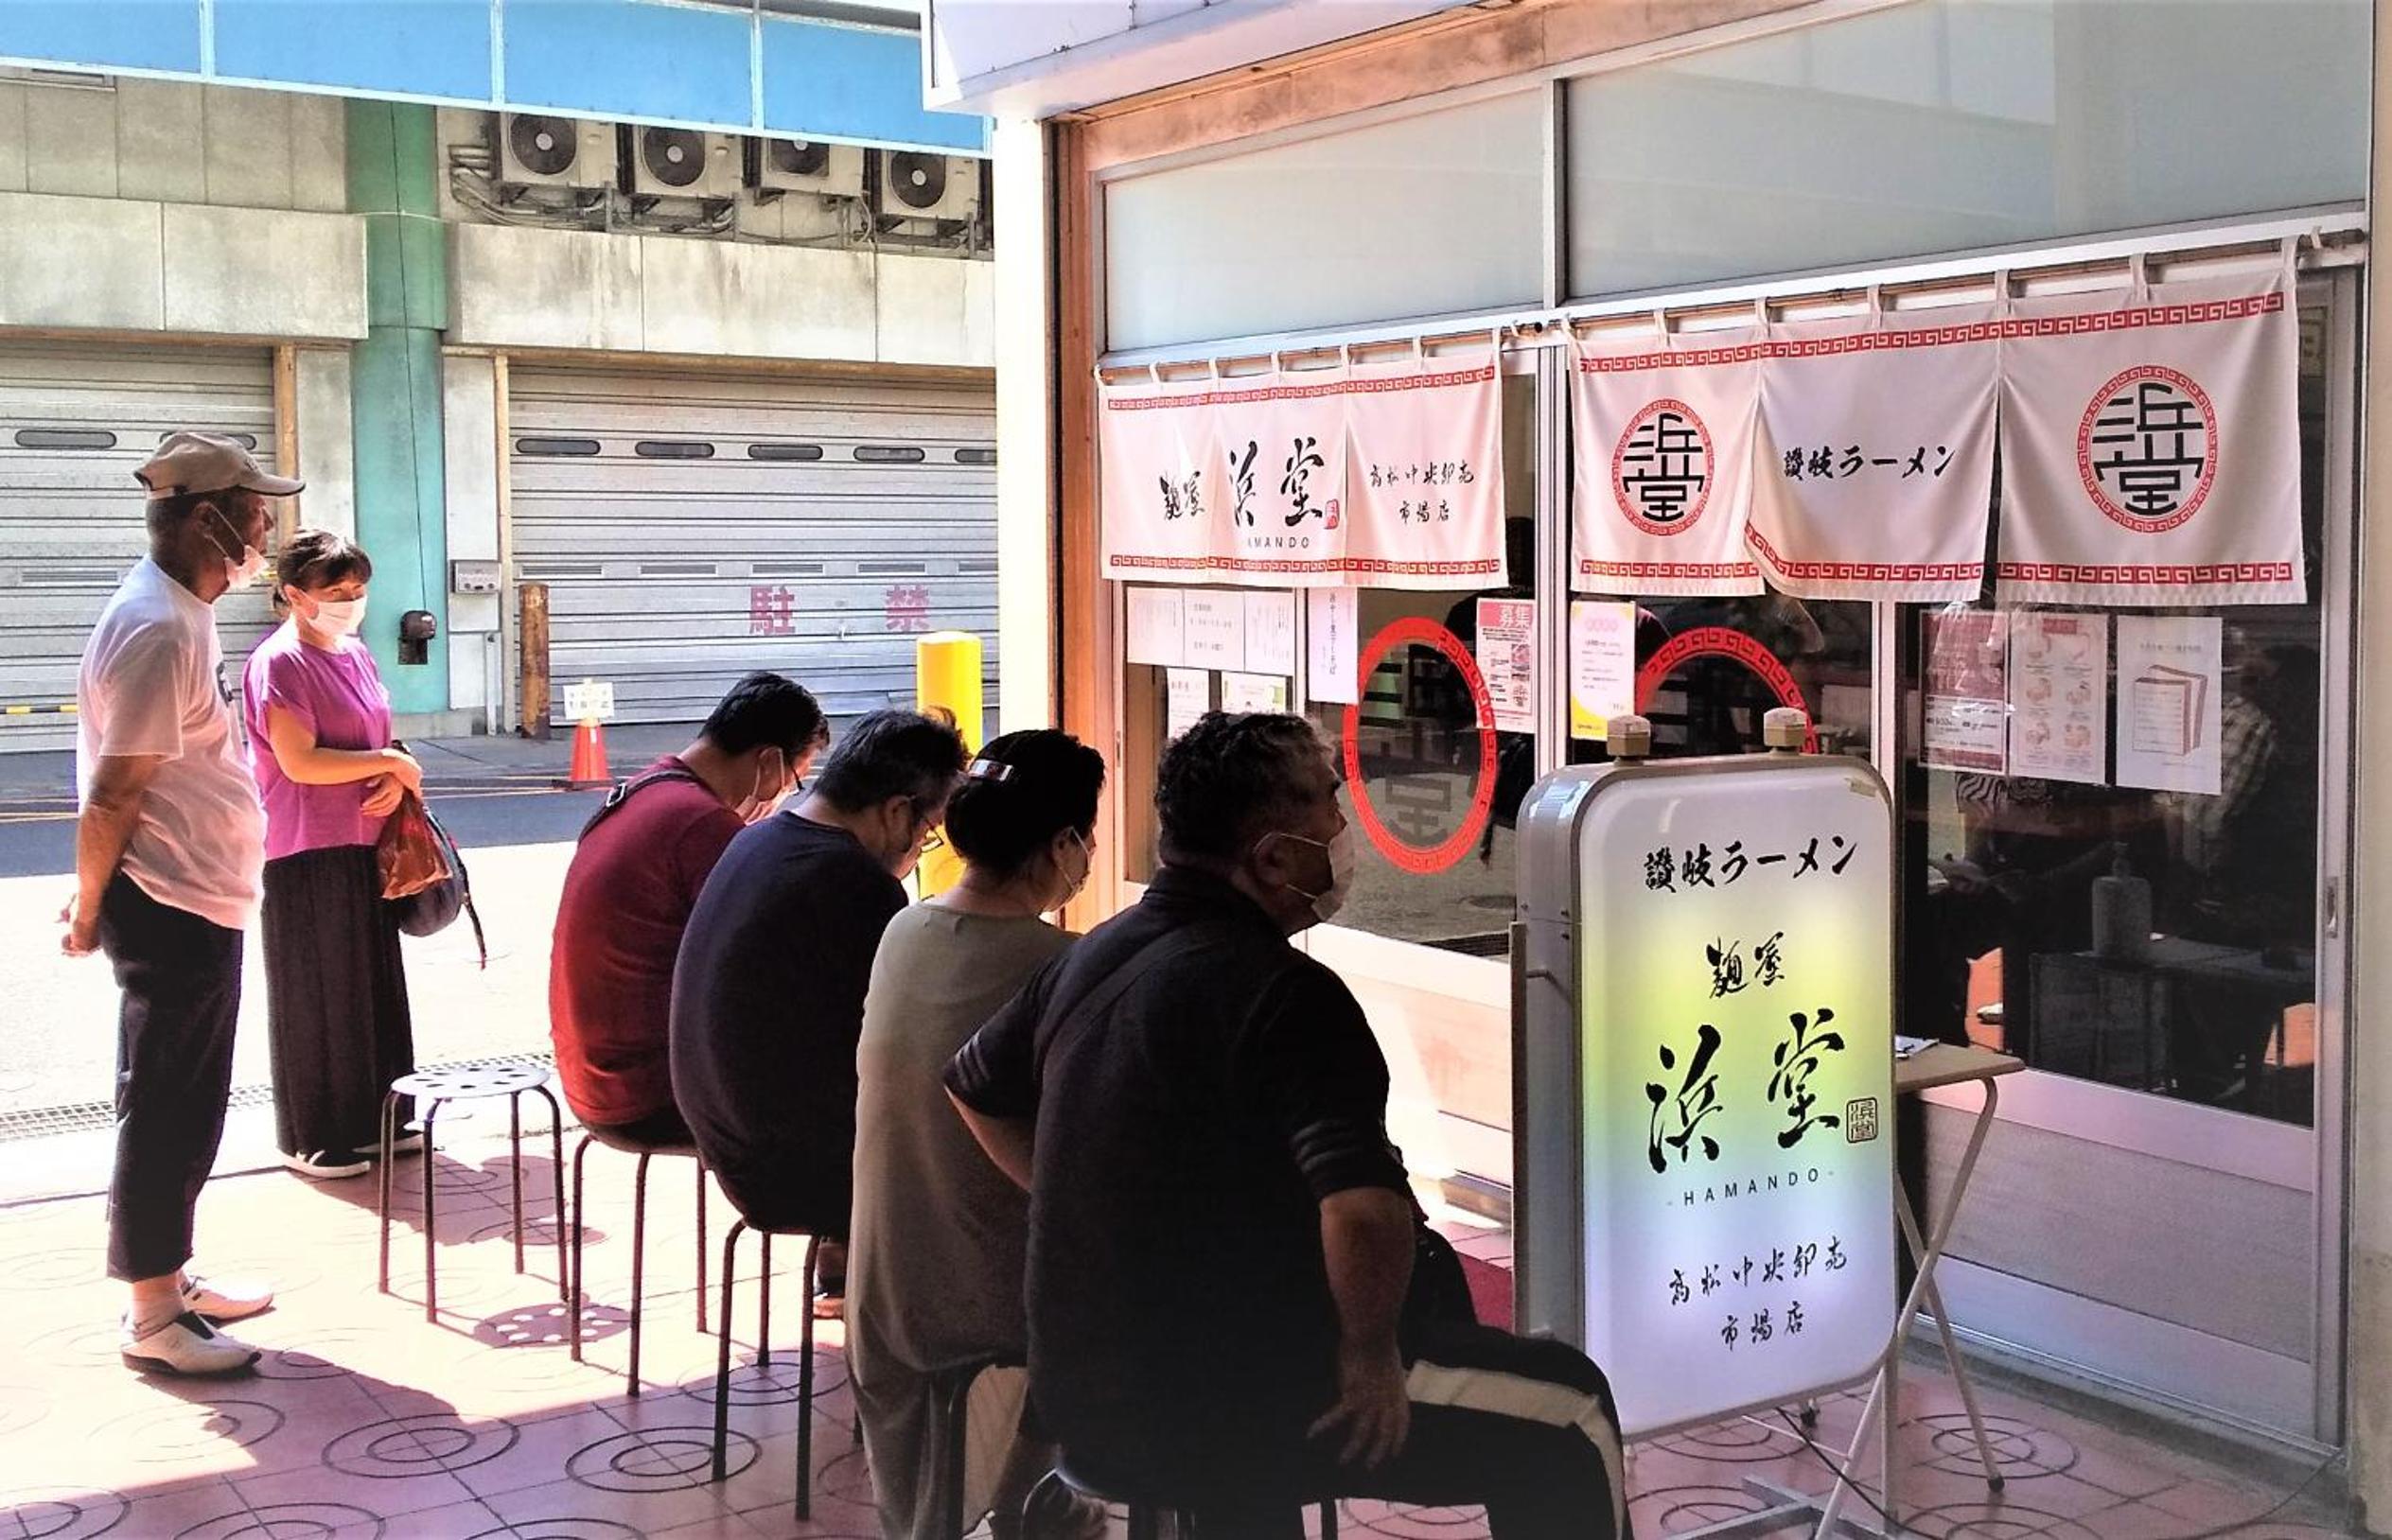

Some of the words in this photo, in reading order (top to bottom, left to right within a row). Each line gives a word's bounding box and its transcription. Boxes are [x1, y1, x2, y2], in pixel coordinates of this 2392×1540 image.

[749, 585, 796, 635] 駐
[886, 584, 930, 632] 禁
[1645, 1008, 1845, 1173] 浜堂
[1684, 1168, 1820, 1206] HAMANDO
[1722, 1301, 1803, 1351] 市場店
